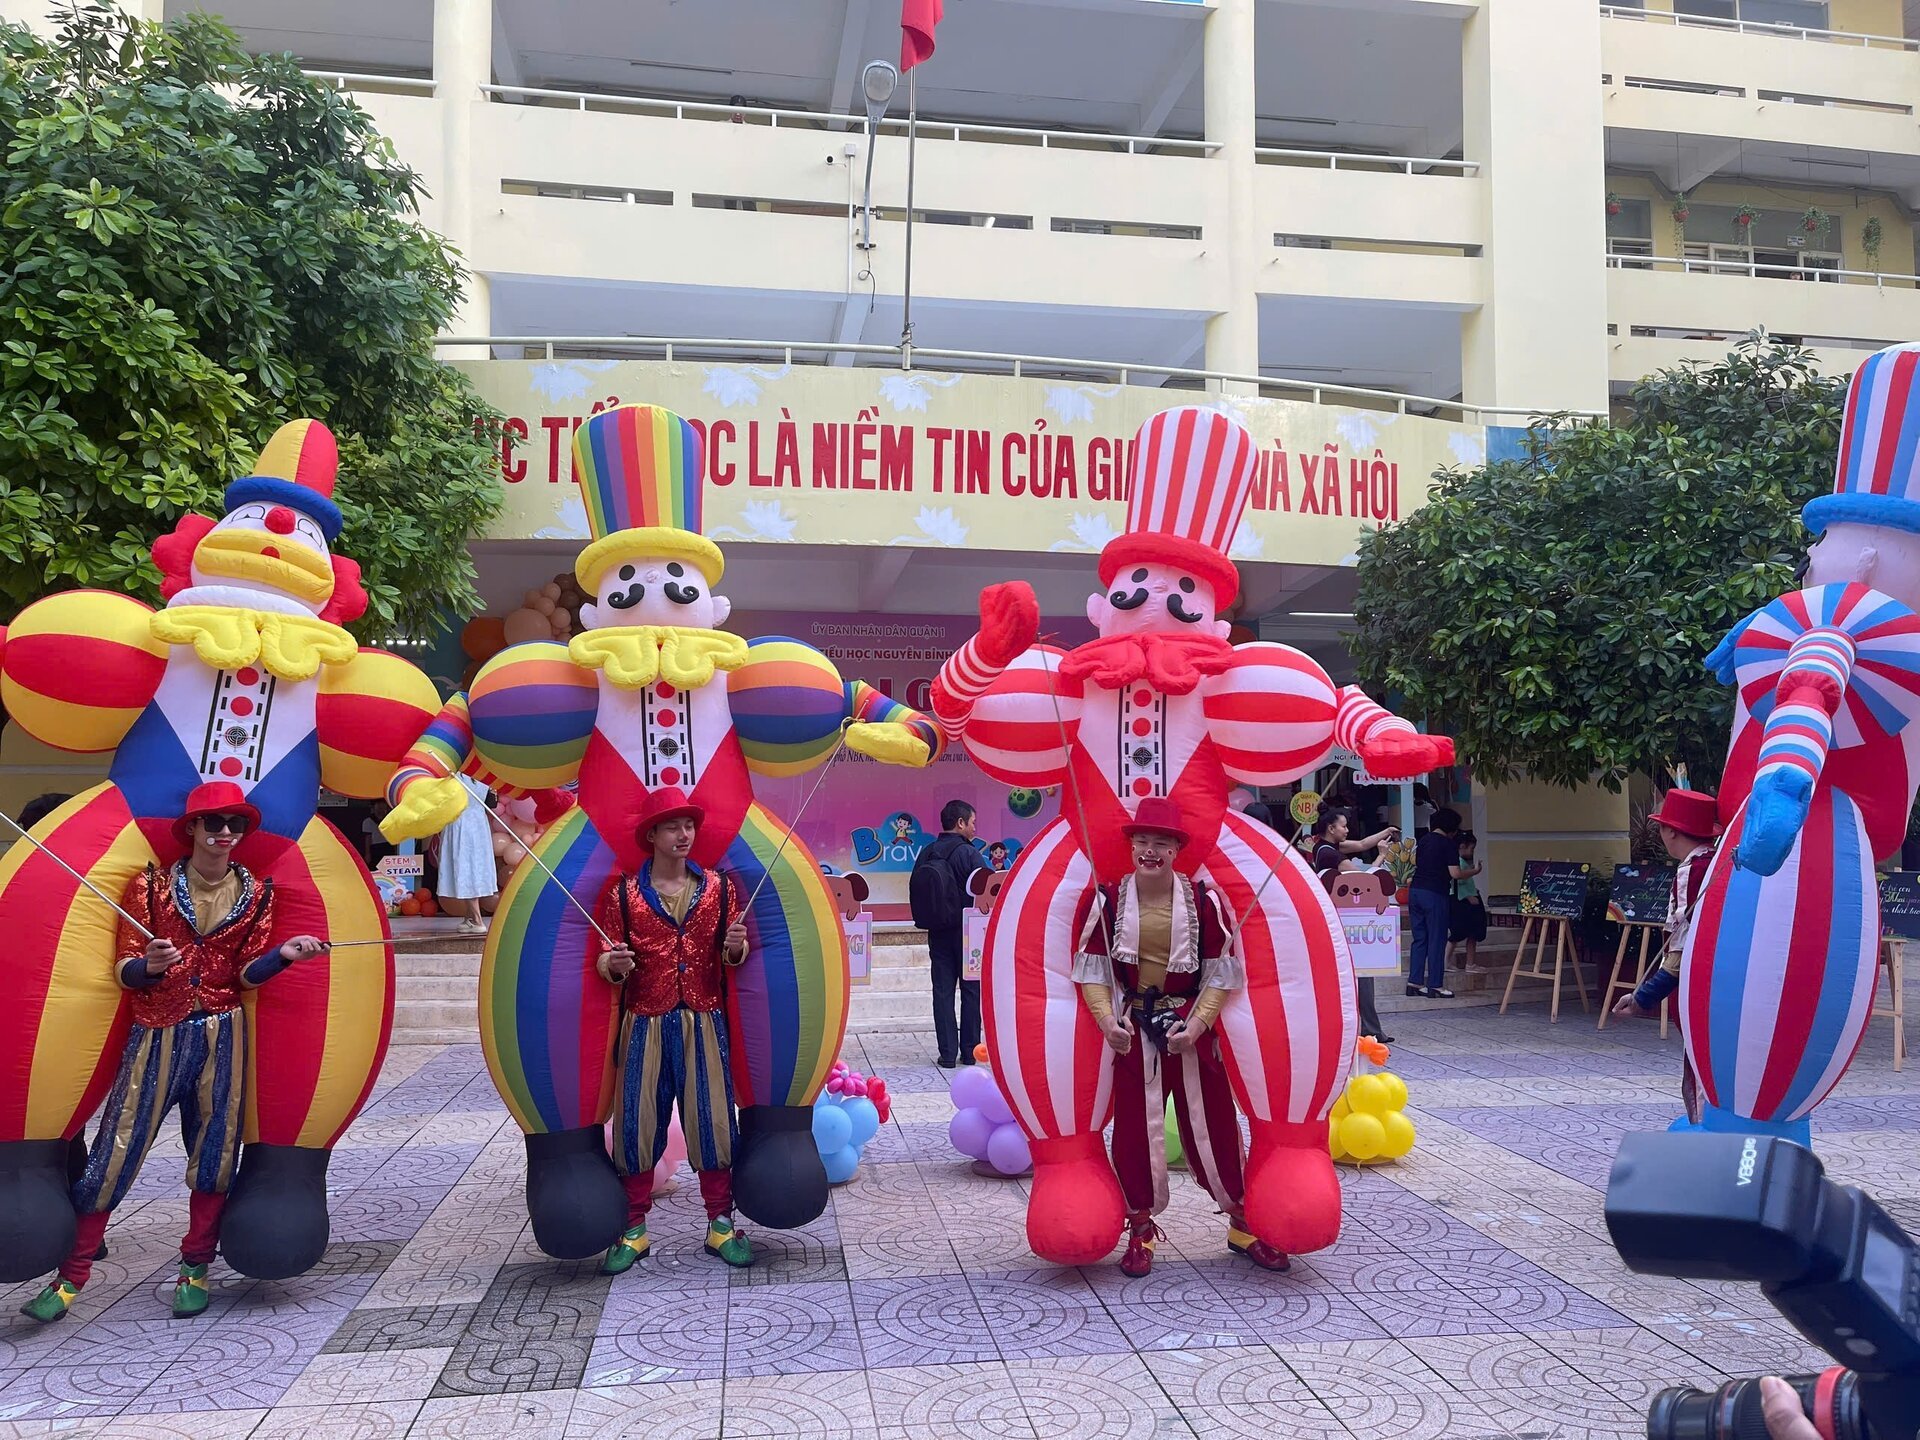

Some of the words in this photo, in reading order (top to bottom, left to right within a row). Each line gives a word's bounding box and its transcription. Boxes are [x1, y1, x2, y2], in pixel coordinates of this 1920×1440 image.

[748, 407, 801, 487] LÀ
[812, 406, 914, 492] NIỀM
[926, 427, 990, 495] TIN
[1002, 418, 1078, 499] CỦA
[1299, 443, 1343, 516] XÃ
[1350, 448, 1398, 532] HỘI
[828, 625, 850, 635] BAN
[853, 623, 883, 636] NHÂN
[885, 624, 907, 637] DÂN
[909, 624, 938, 639] QUẬN
[940, 627, 946, 637] 1
[847, 649, 871, 661] HỌC
[851, 827, 923, 866] Brav
[385, 857, 410, 865] STEM
[386, 867, 421, 875] STEAM
[1344, 920, 1392, 944] HÚC
